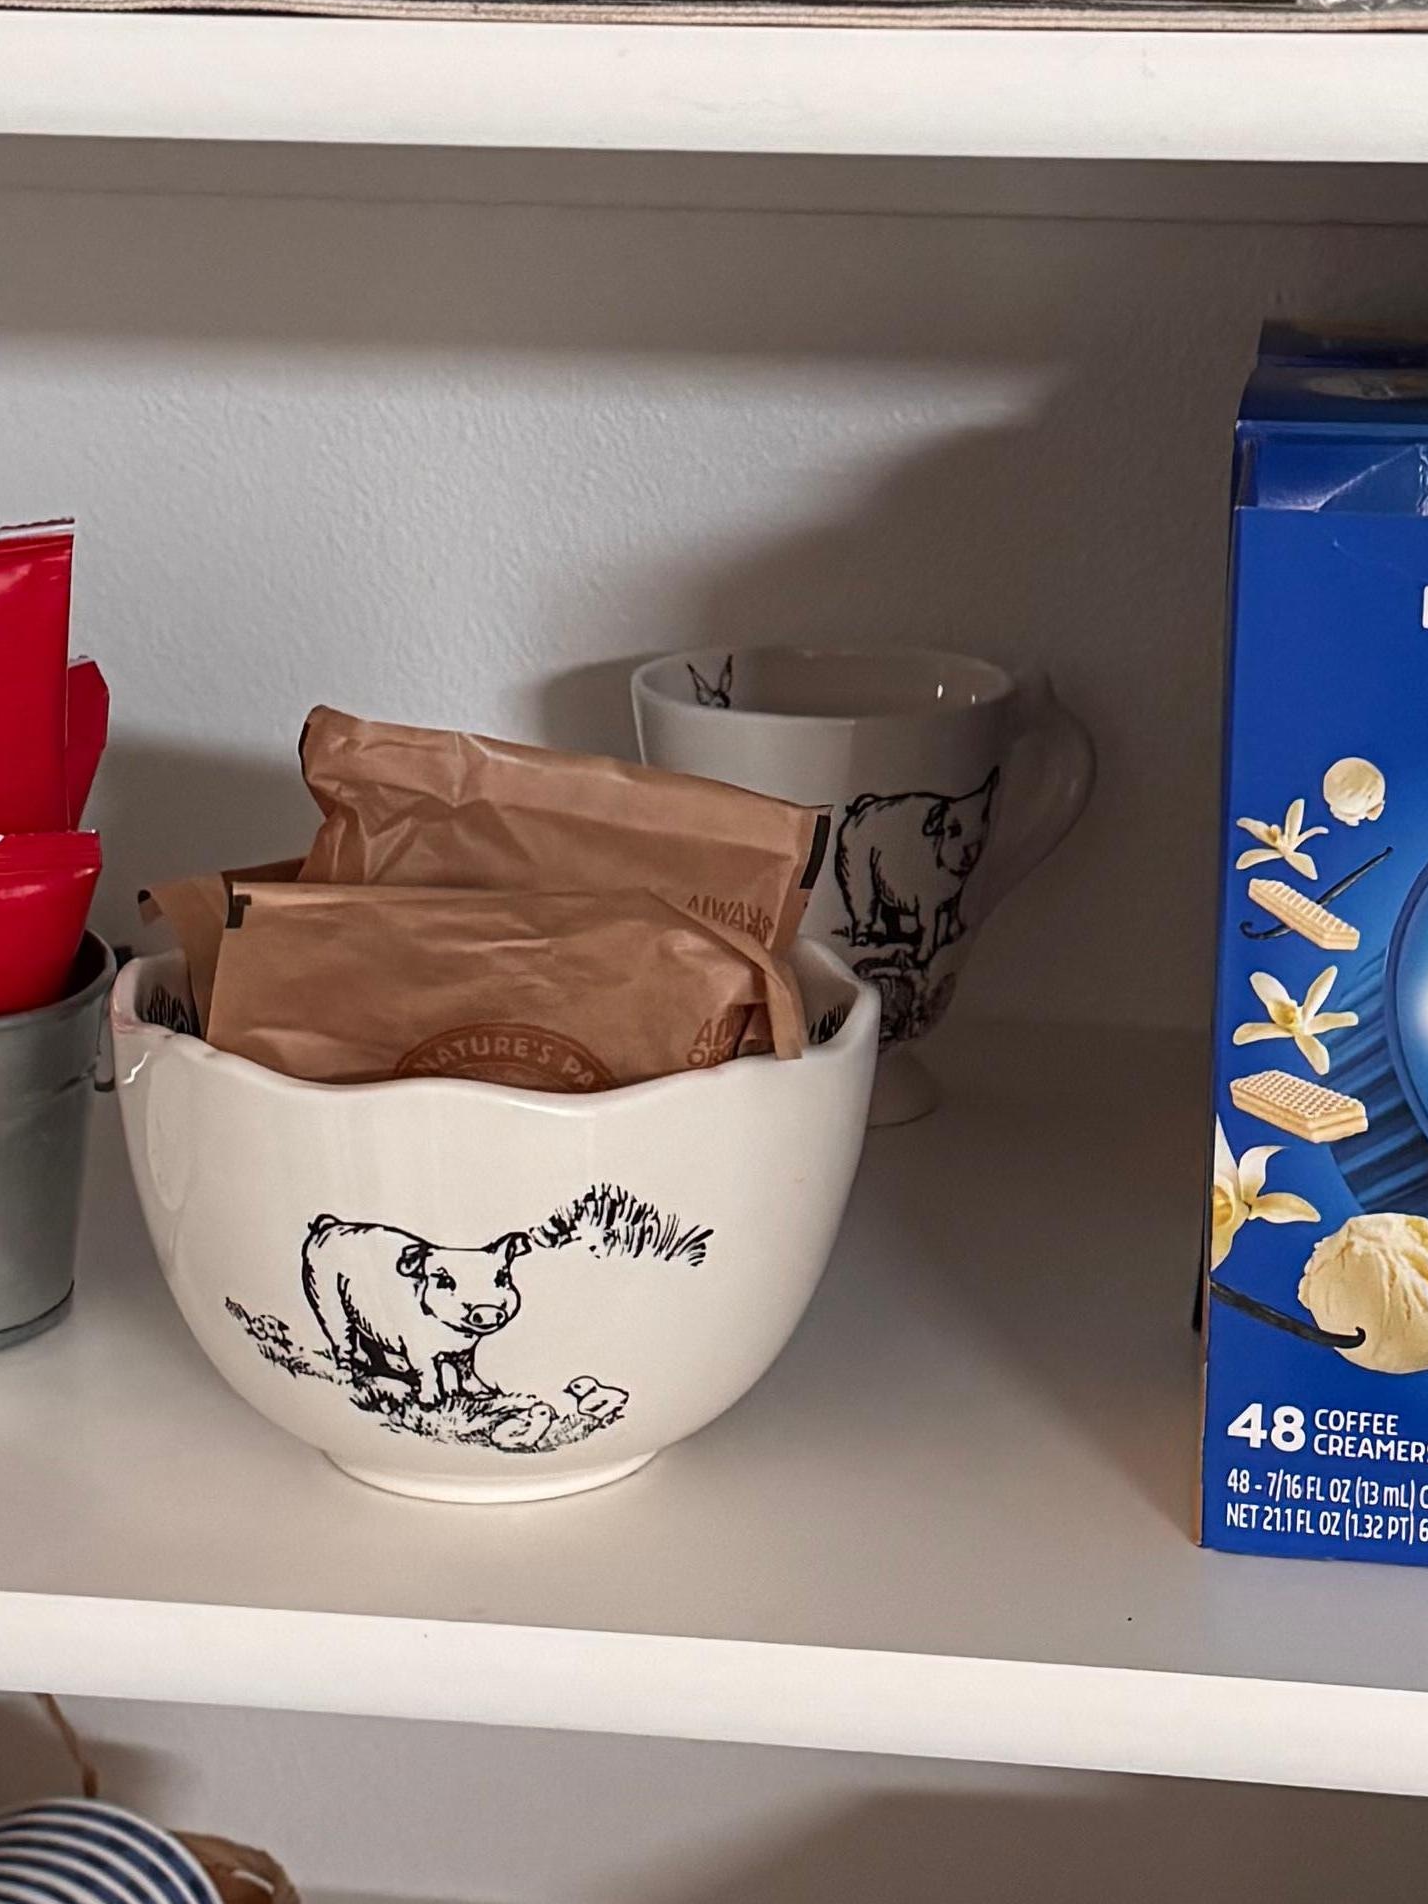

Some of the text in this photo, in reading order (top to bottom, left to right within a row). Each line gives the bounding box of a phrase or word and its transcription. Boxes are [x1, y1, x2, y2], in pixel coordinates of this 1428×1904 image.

[1227, 1402, 1306, 1453] 48
[1314, 1408, 1399, 1436] COFFEE
[1226, 1468, 1250, 1495] 48
[1267, 1469, 1303, 1503] 7/16
[1306, 1475, 1325, 1503] FL
[1329, 1478, 1351, 1504] OZ
[1355, 1476, 1379, 1509] (13
[1383, 1479, 1416, 1512] mL)
[1226, 1502, 1260, 1528] NET
[1263, 1506, 1291, 1533] 21.1
[1296, 1508, 1315, 1534] FL
[1319, 1511, 1340, 1537] OZ
[1344, 1508, 1383, 1542] (1.32
[1387, 1511, 1415, 1546] PT)
